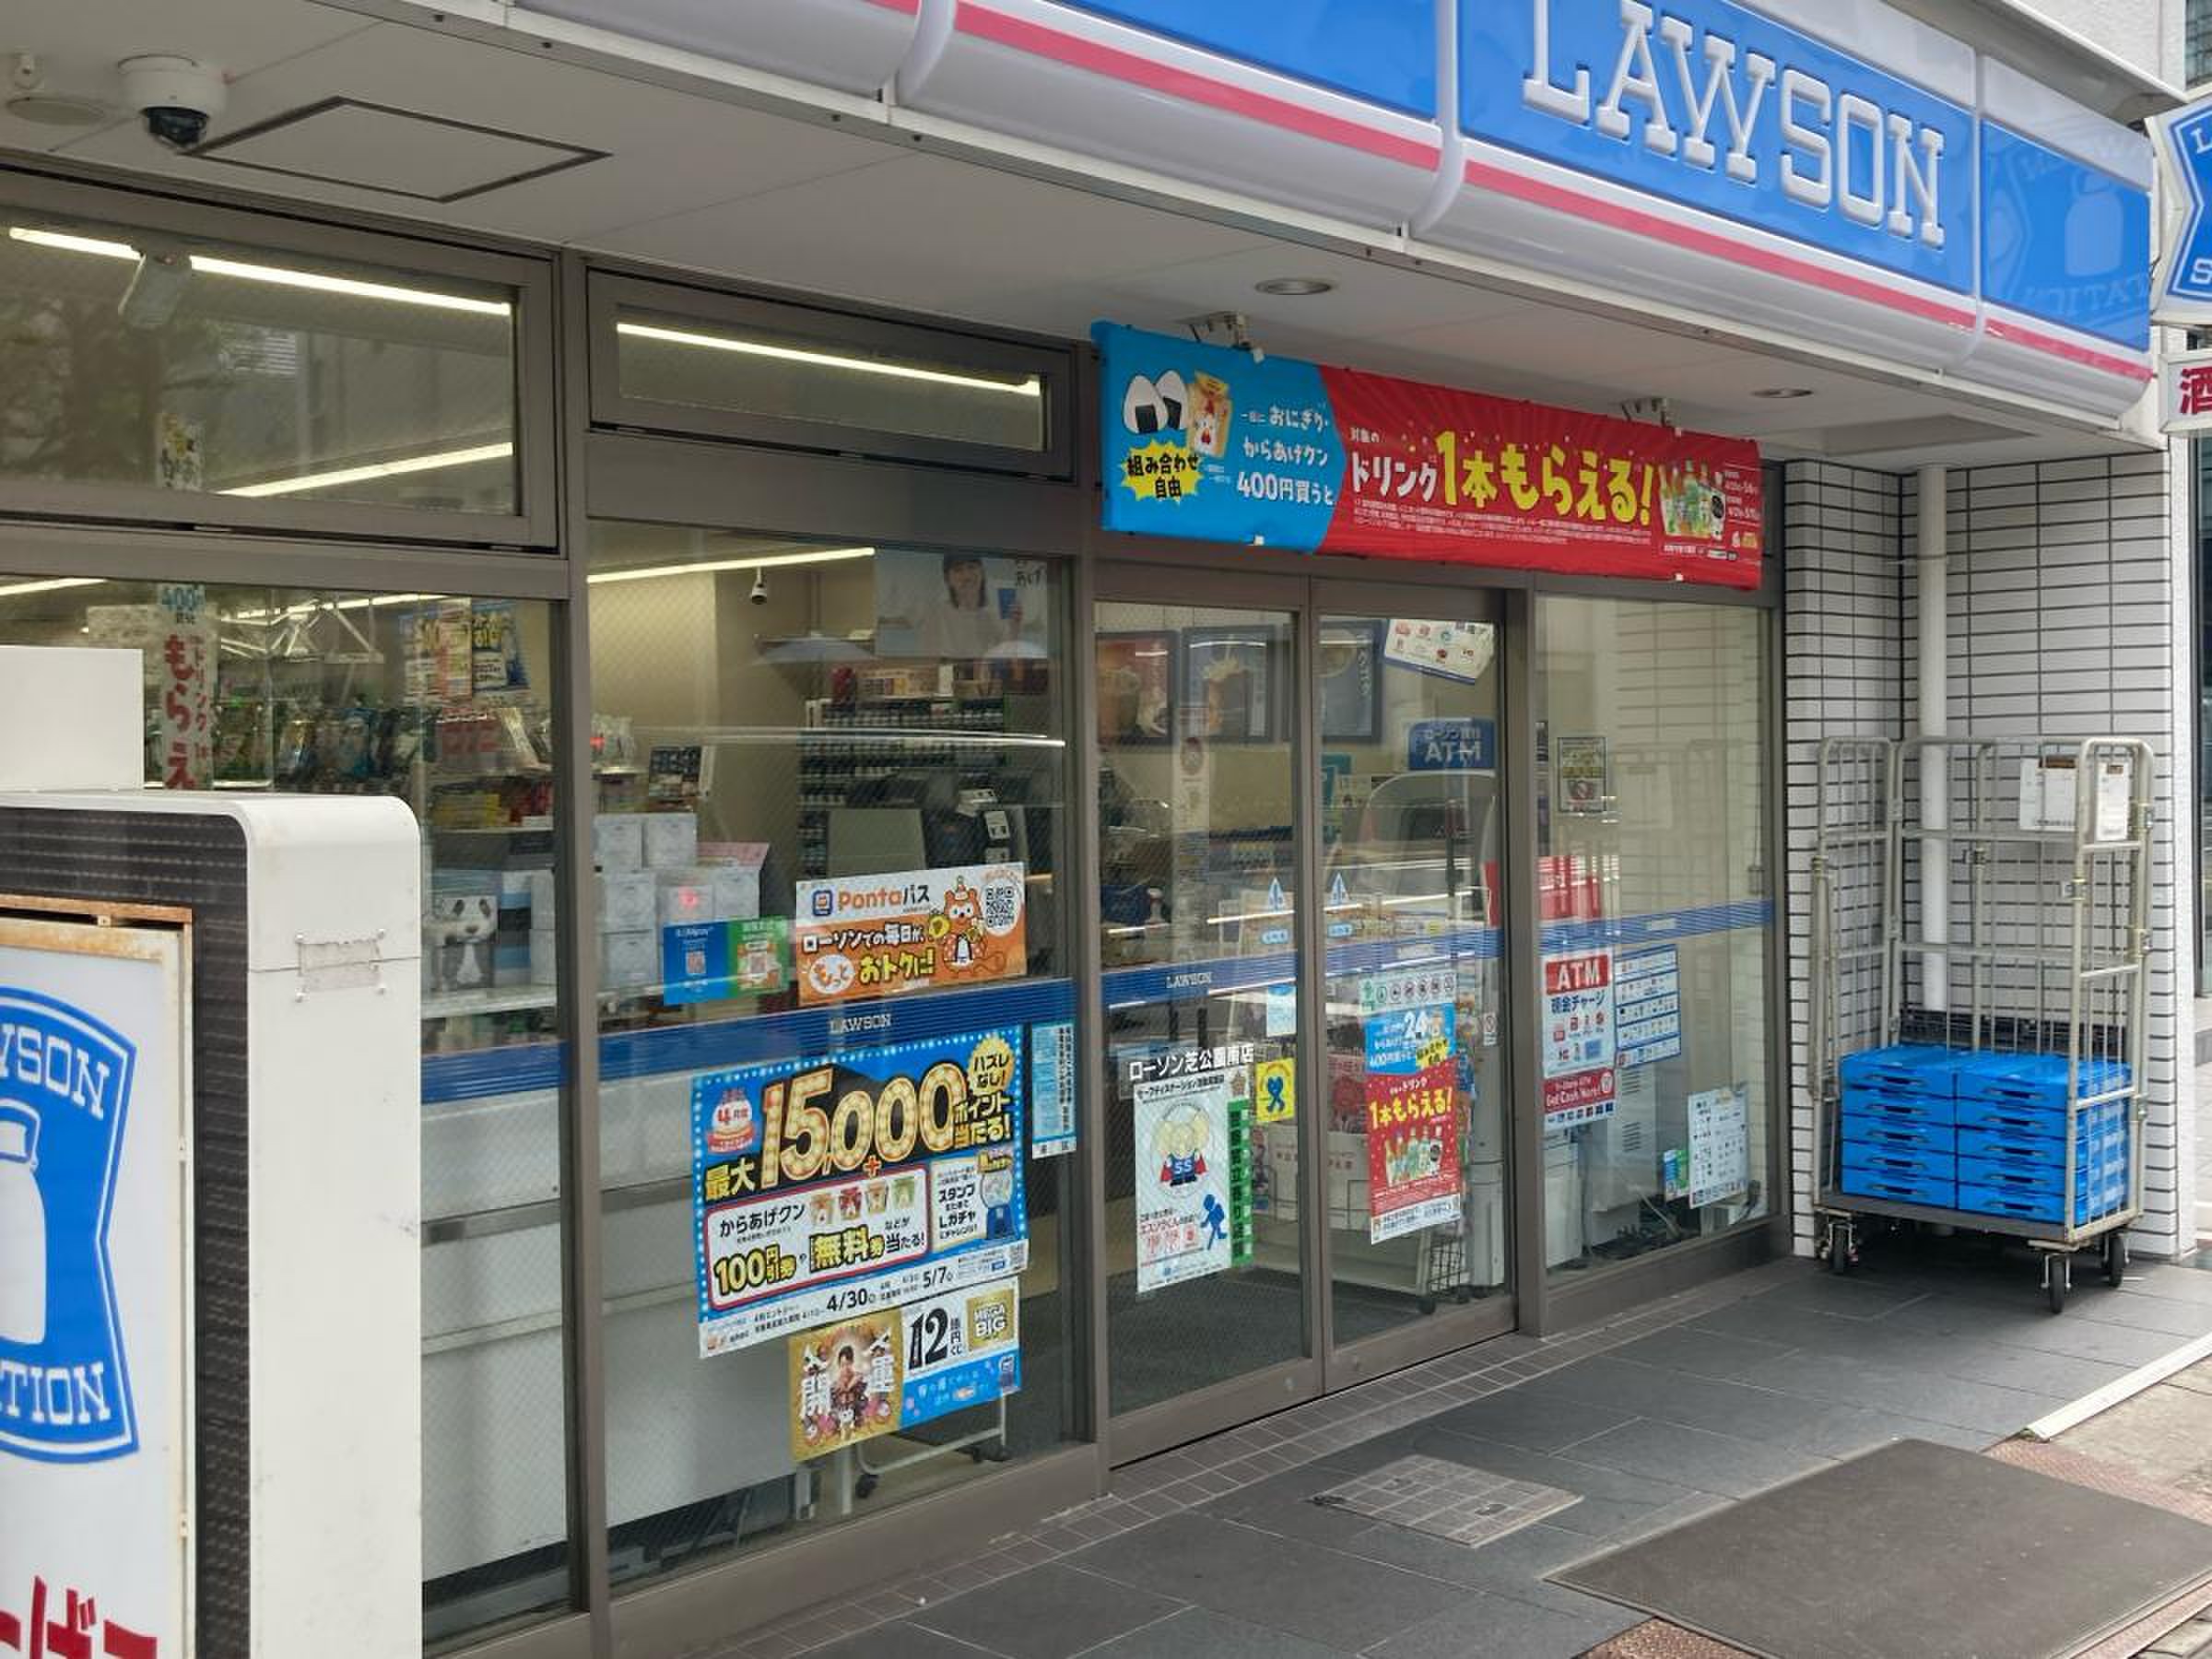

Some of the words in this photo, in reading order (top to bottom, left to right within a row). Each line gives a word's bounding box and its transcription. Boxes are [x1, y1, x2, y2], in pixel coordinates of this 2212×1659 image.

[1524, 0, 1945, 249] LAWSON
[1126, 452, 1199, 476] 組み合わせ
[1243, 435, 1327, 466] からあげクン
[1154, 476, 1182, 499] 自由
[1237, 471, 1335, 506] 400円買うと
[1424, 741, 1481, 764] ATM
[838, 885, 930, 912] Pontaパス
[1558, 959, 1599, 991] ATM
[830, 1014, 891, 1034] LAWSON
[761, 1063, 968, 1189] 15,000
[706, 1159, 756, 1201] 最大
[1173, 1159, 1193, 1176] SS
[938, 1182, 975, 1203] スタンプ
[719, 1205, 806, 1238] からあげクン
[939, 1210, 976, 1229] Lガチャ
[827, 1288, 868, 1312] 4/30
[922, 1265, 947, 1288] 5/7
[909, 1308, 948, 1371] 12
[0, 1359, 111, 1425] TION
